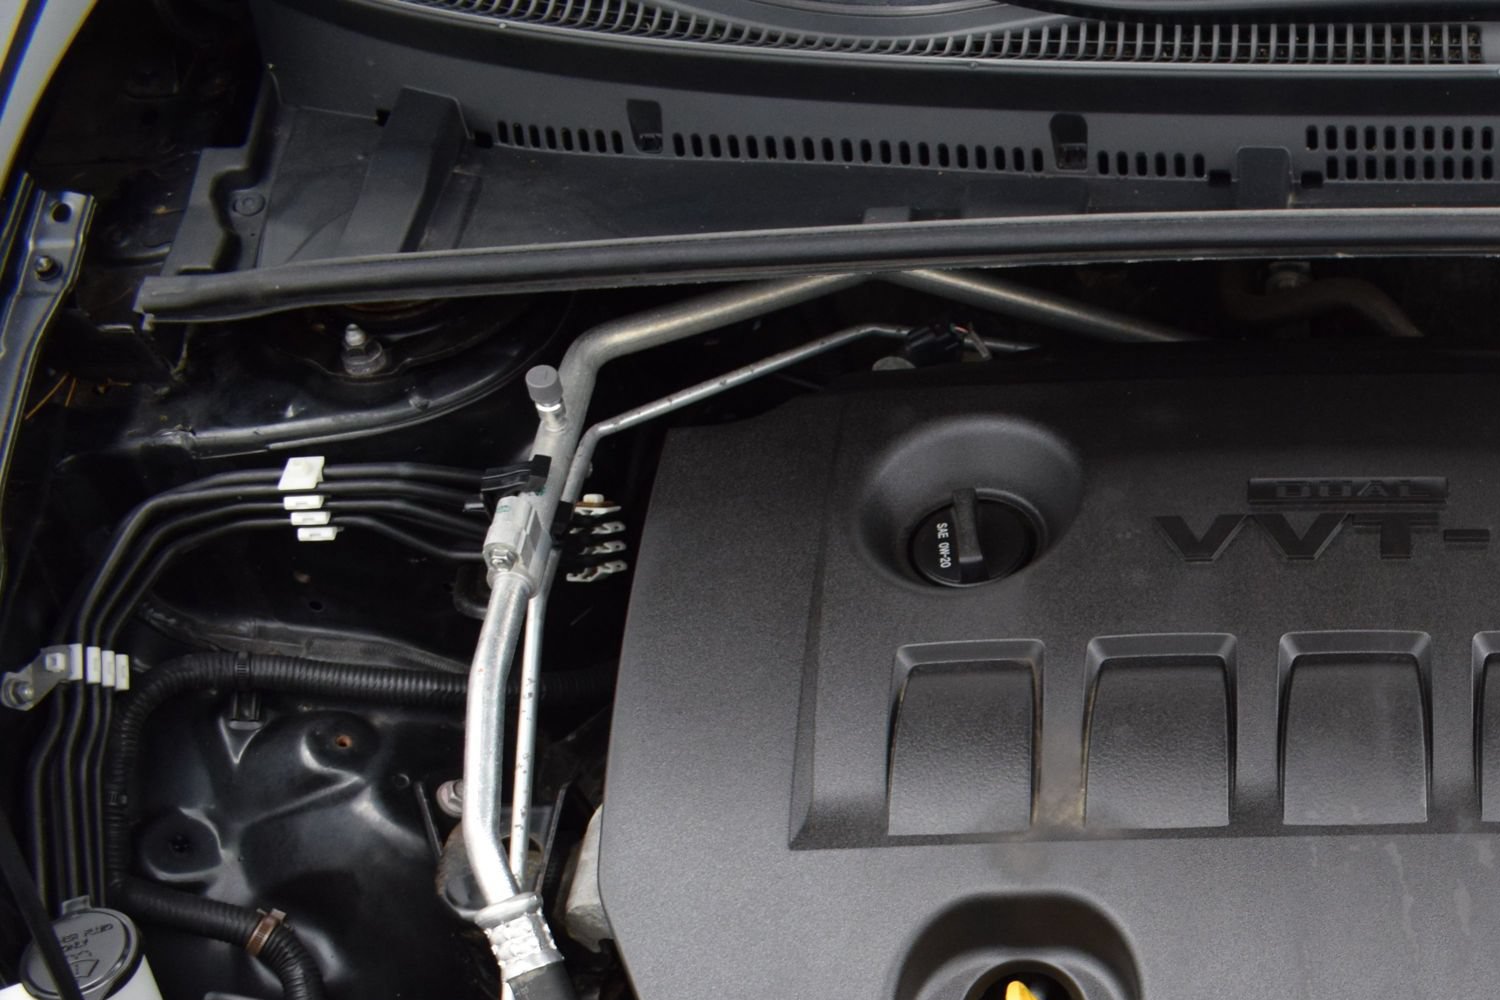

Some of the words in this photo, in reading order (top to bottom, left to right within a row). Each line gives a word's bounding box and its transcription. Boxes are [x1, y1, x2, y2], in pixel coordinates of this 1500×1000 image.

[1275, 479, 1432, 498] DUAL
[936, 522, 949, 539] SAE
[938, 542, 952, 568] 0W-20
